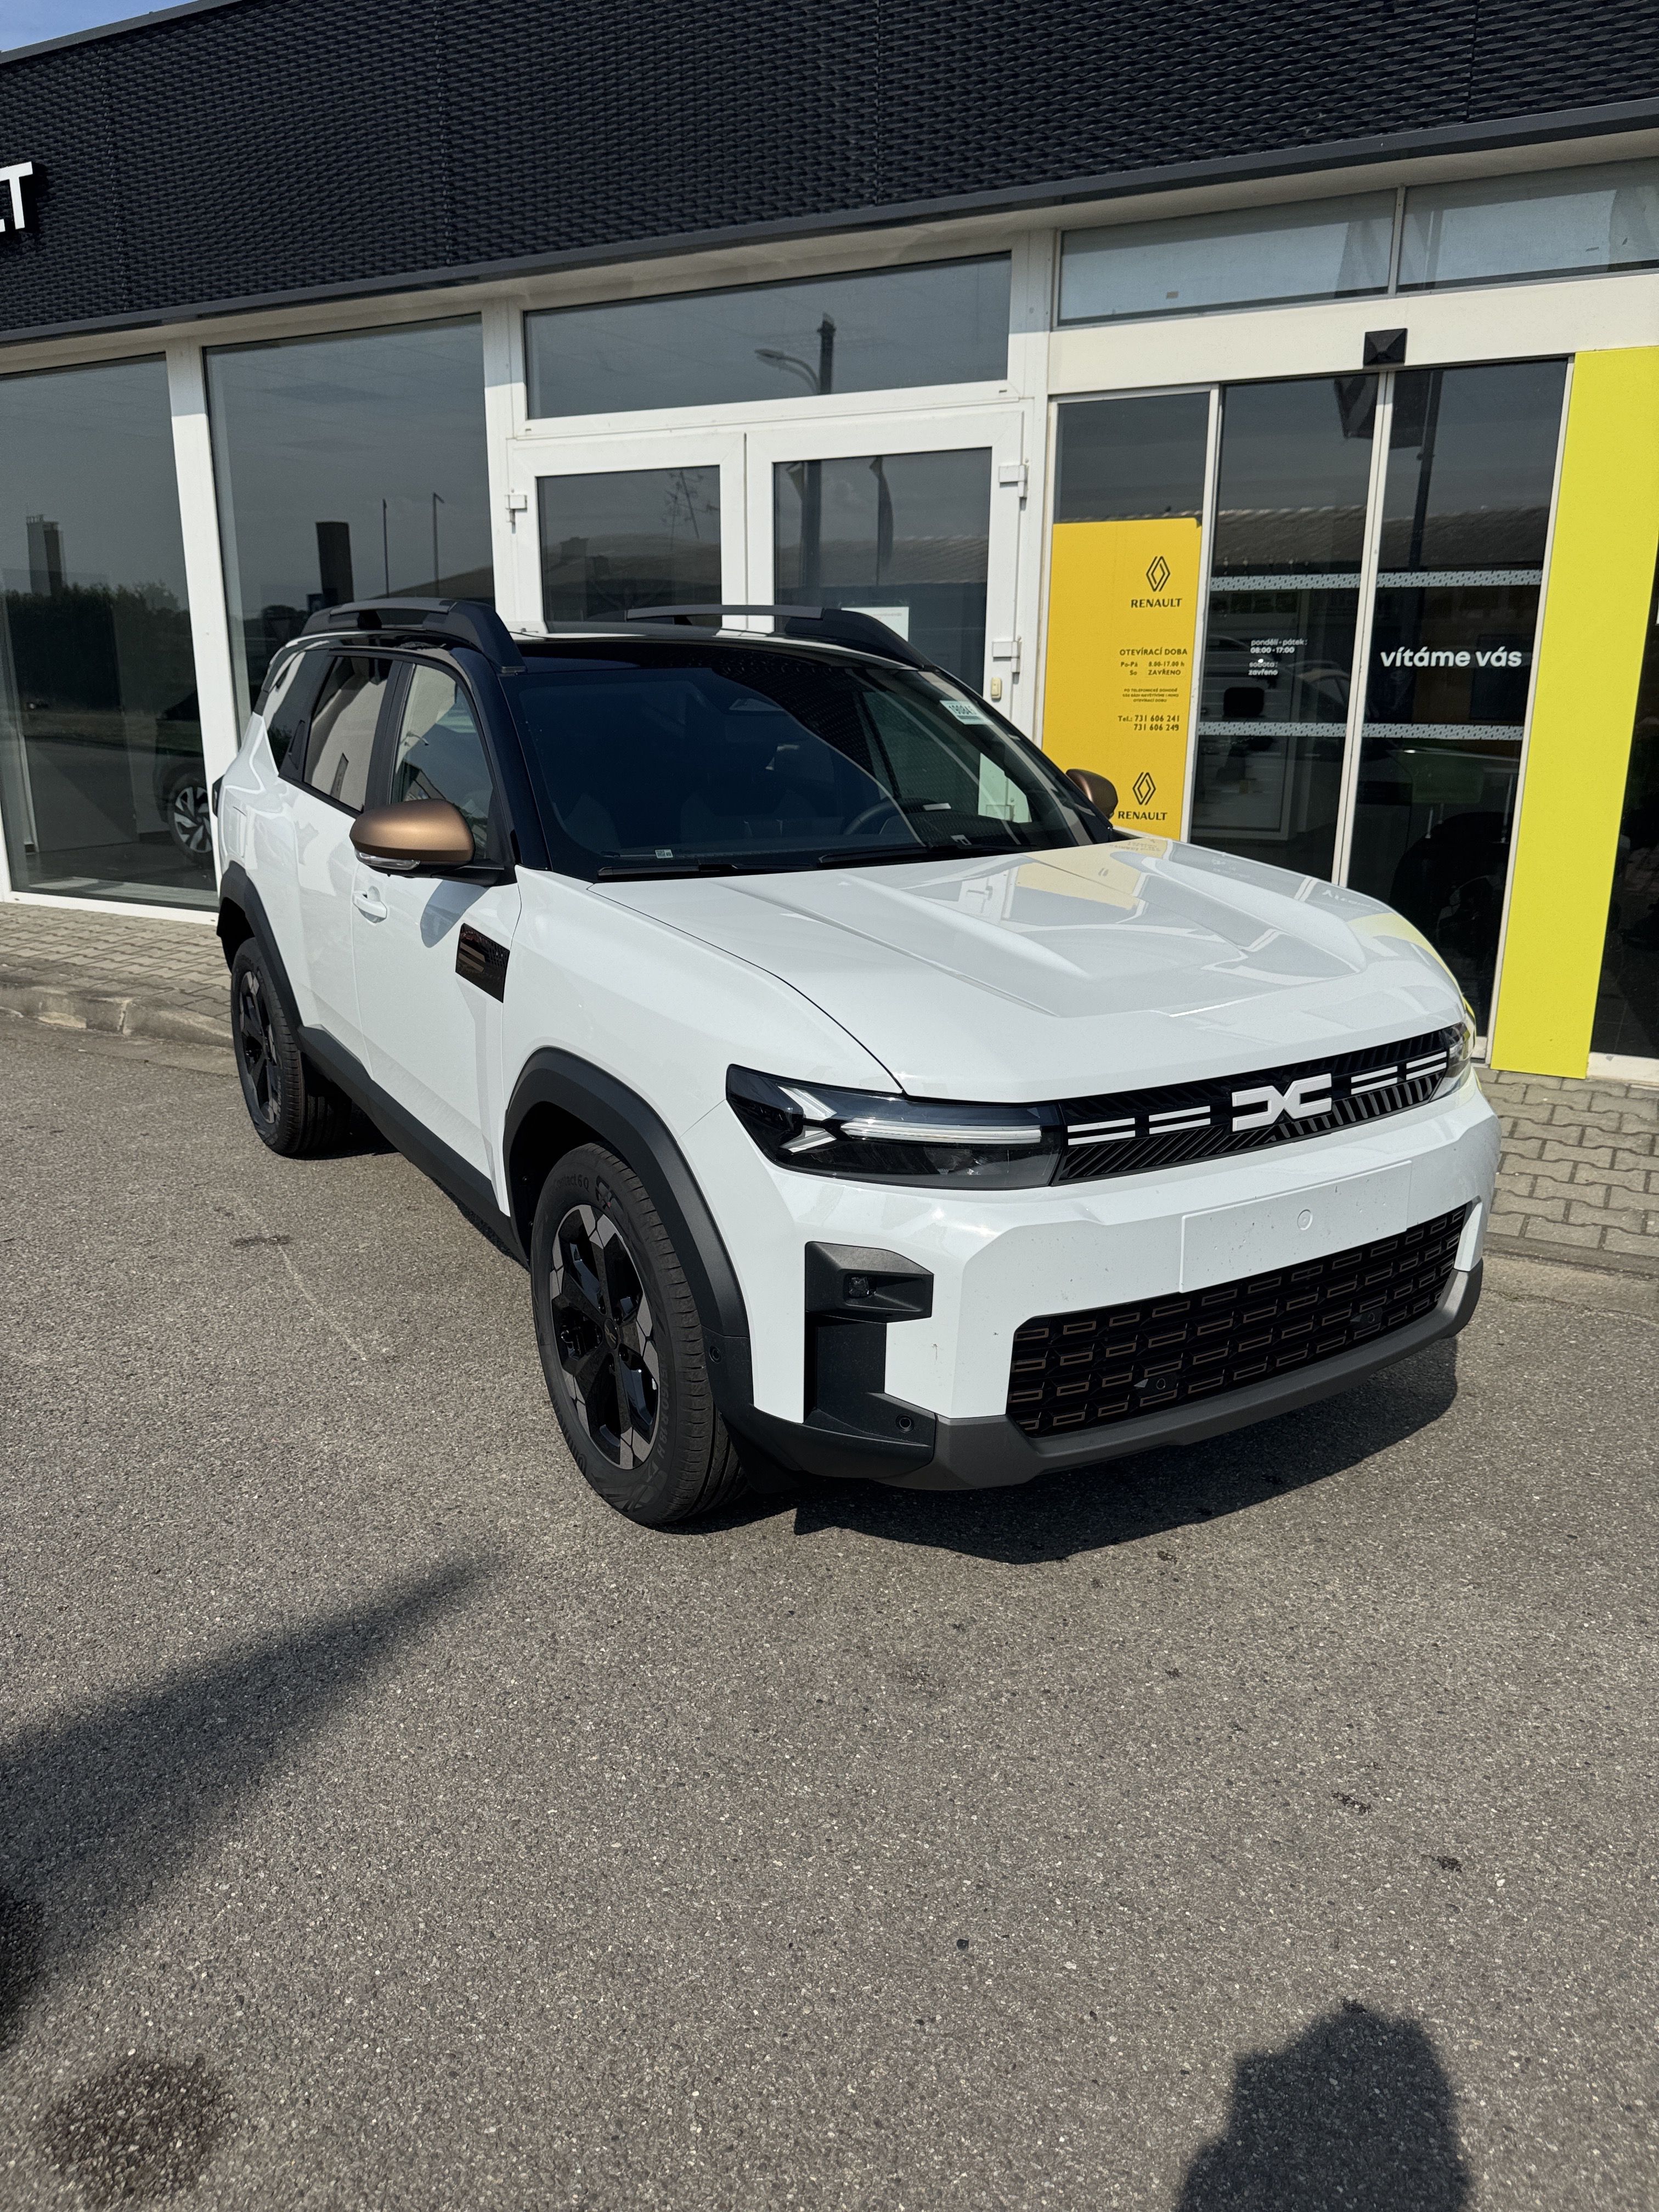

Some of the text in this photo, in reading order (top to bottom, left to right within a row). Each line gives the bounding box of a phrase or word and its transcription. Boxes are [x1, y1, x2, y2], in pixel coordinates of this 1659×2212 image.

[0, 161, 33, 233] T
[1131, 598, 1182, 608] RENAULT
[1120, 647, 1163, 656] OTEVÍRACÍ
[1380, 646, 1522, 667] vítáme vás
[1118, 811, 1167, 820] RENAULT
